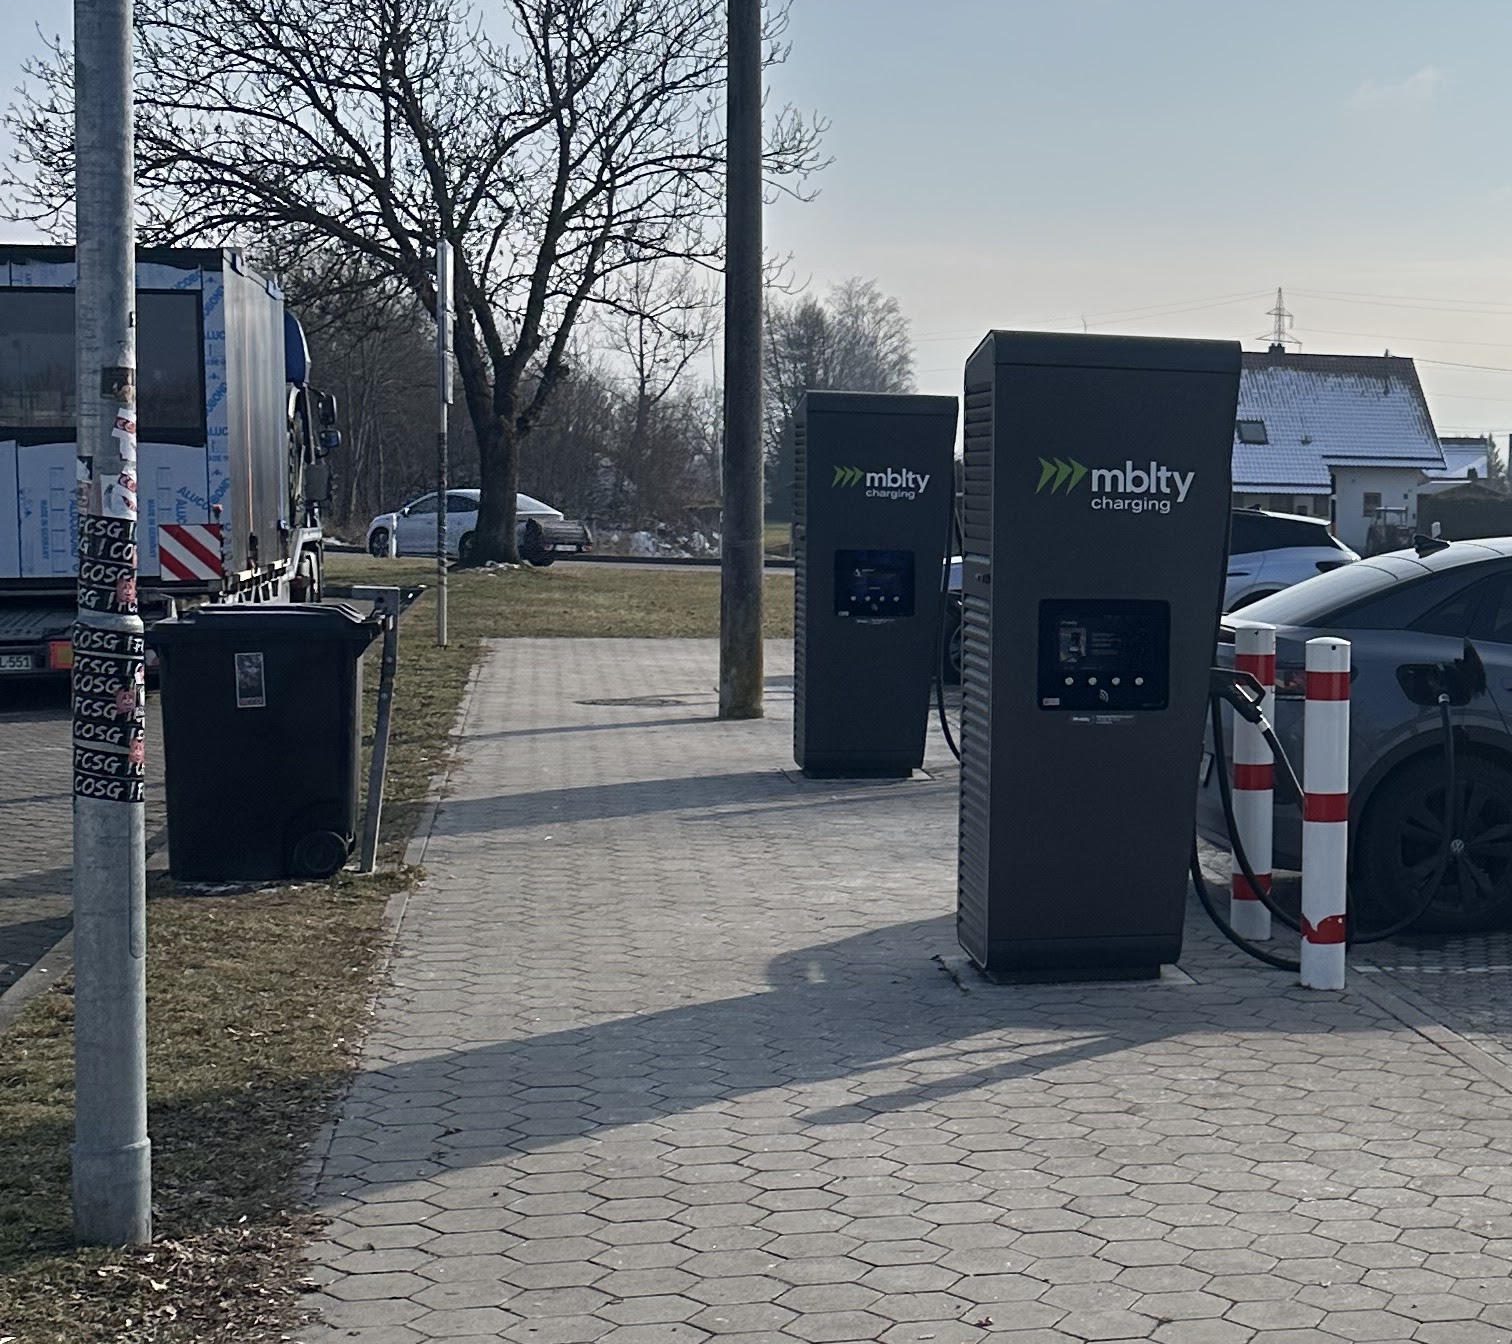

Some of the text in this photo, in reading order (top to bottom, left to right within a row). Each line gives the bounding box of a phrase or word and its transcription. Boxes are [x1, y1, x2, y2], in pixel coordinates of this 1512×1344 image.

[866, 467, 931, 494] mblty
[1091, 460, 1195, 503] mblty
[865, 488, 916, 501] charging
[1091, 495, 1171, 514] charging
[74, 720, 124, 744] COSG
[74, 749, 122, 775] FCSG
[74, 775, 125, 800] COSG
